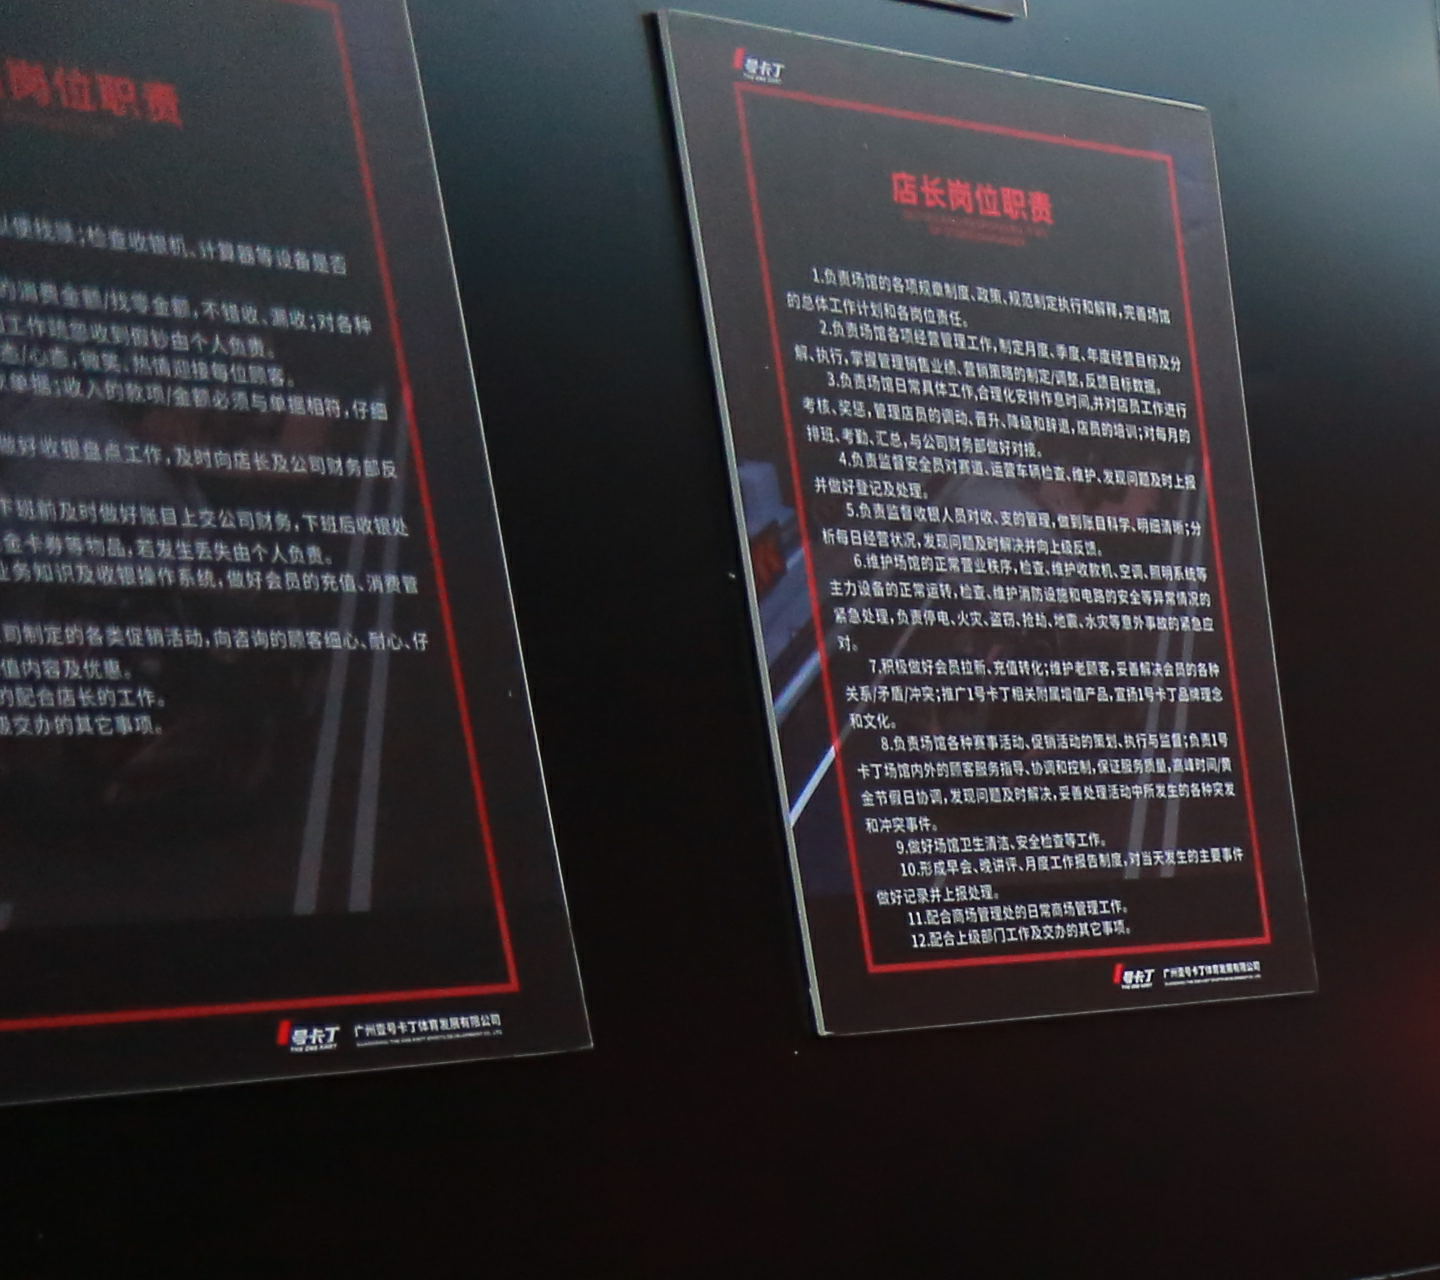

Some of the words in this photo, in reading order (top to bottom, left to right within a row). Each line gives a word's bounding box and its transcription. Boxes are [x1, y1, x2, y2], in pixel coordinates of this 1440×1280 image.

[891, 171, 1054, 224] 店长岗位职责
